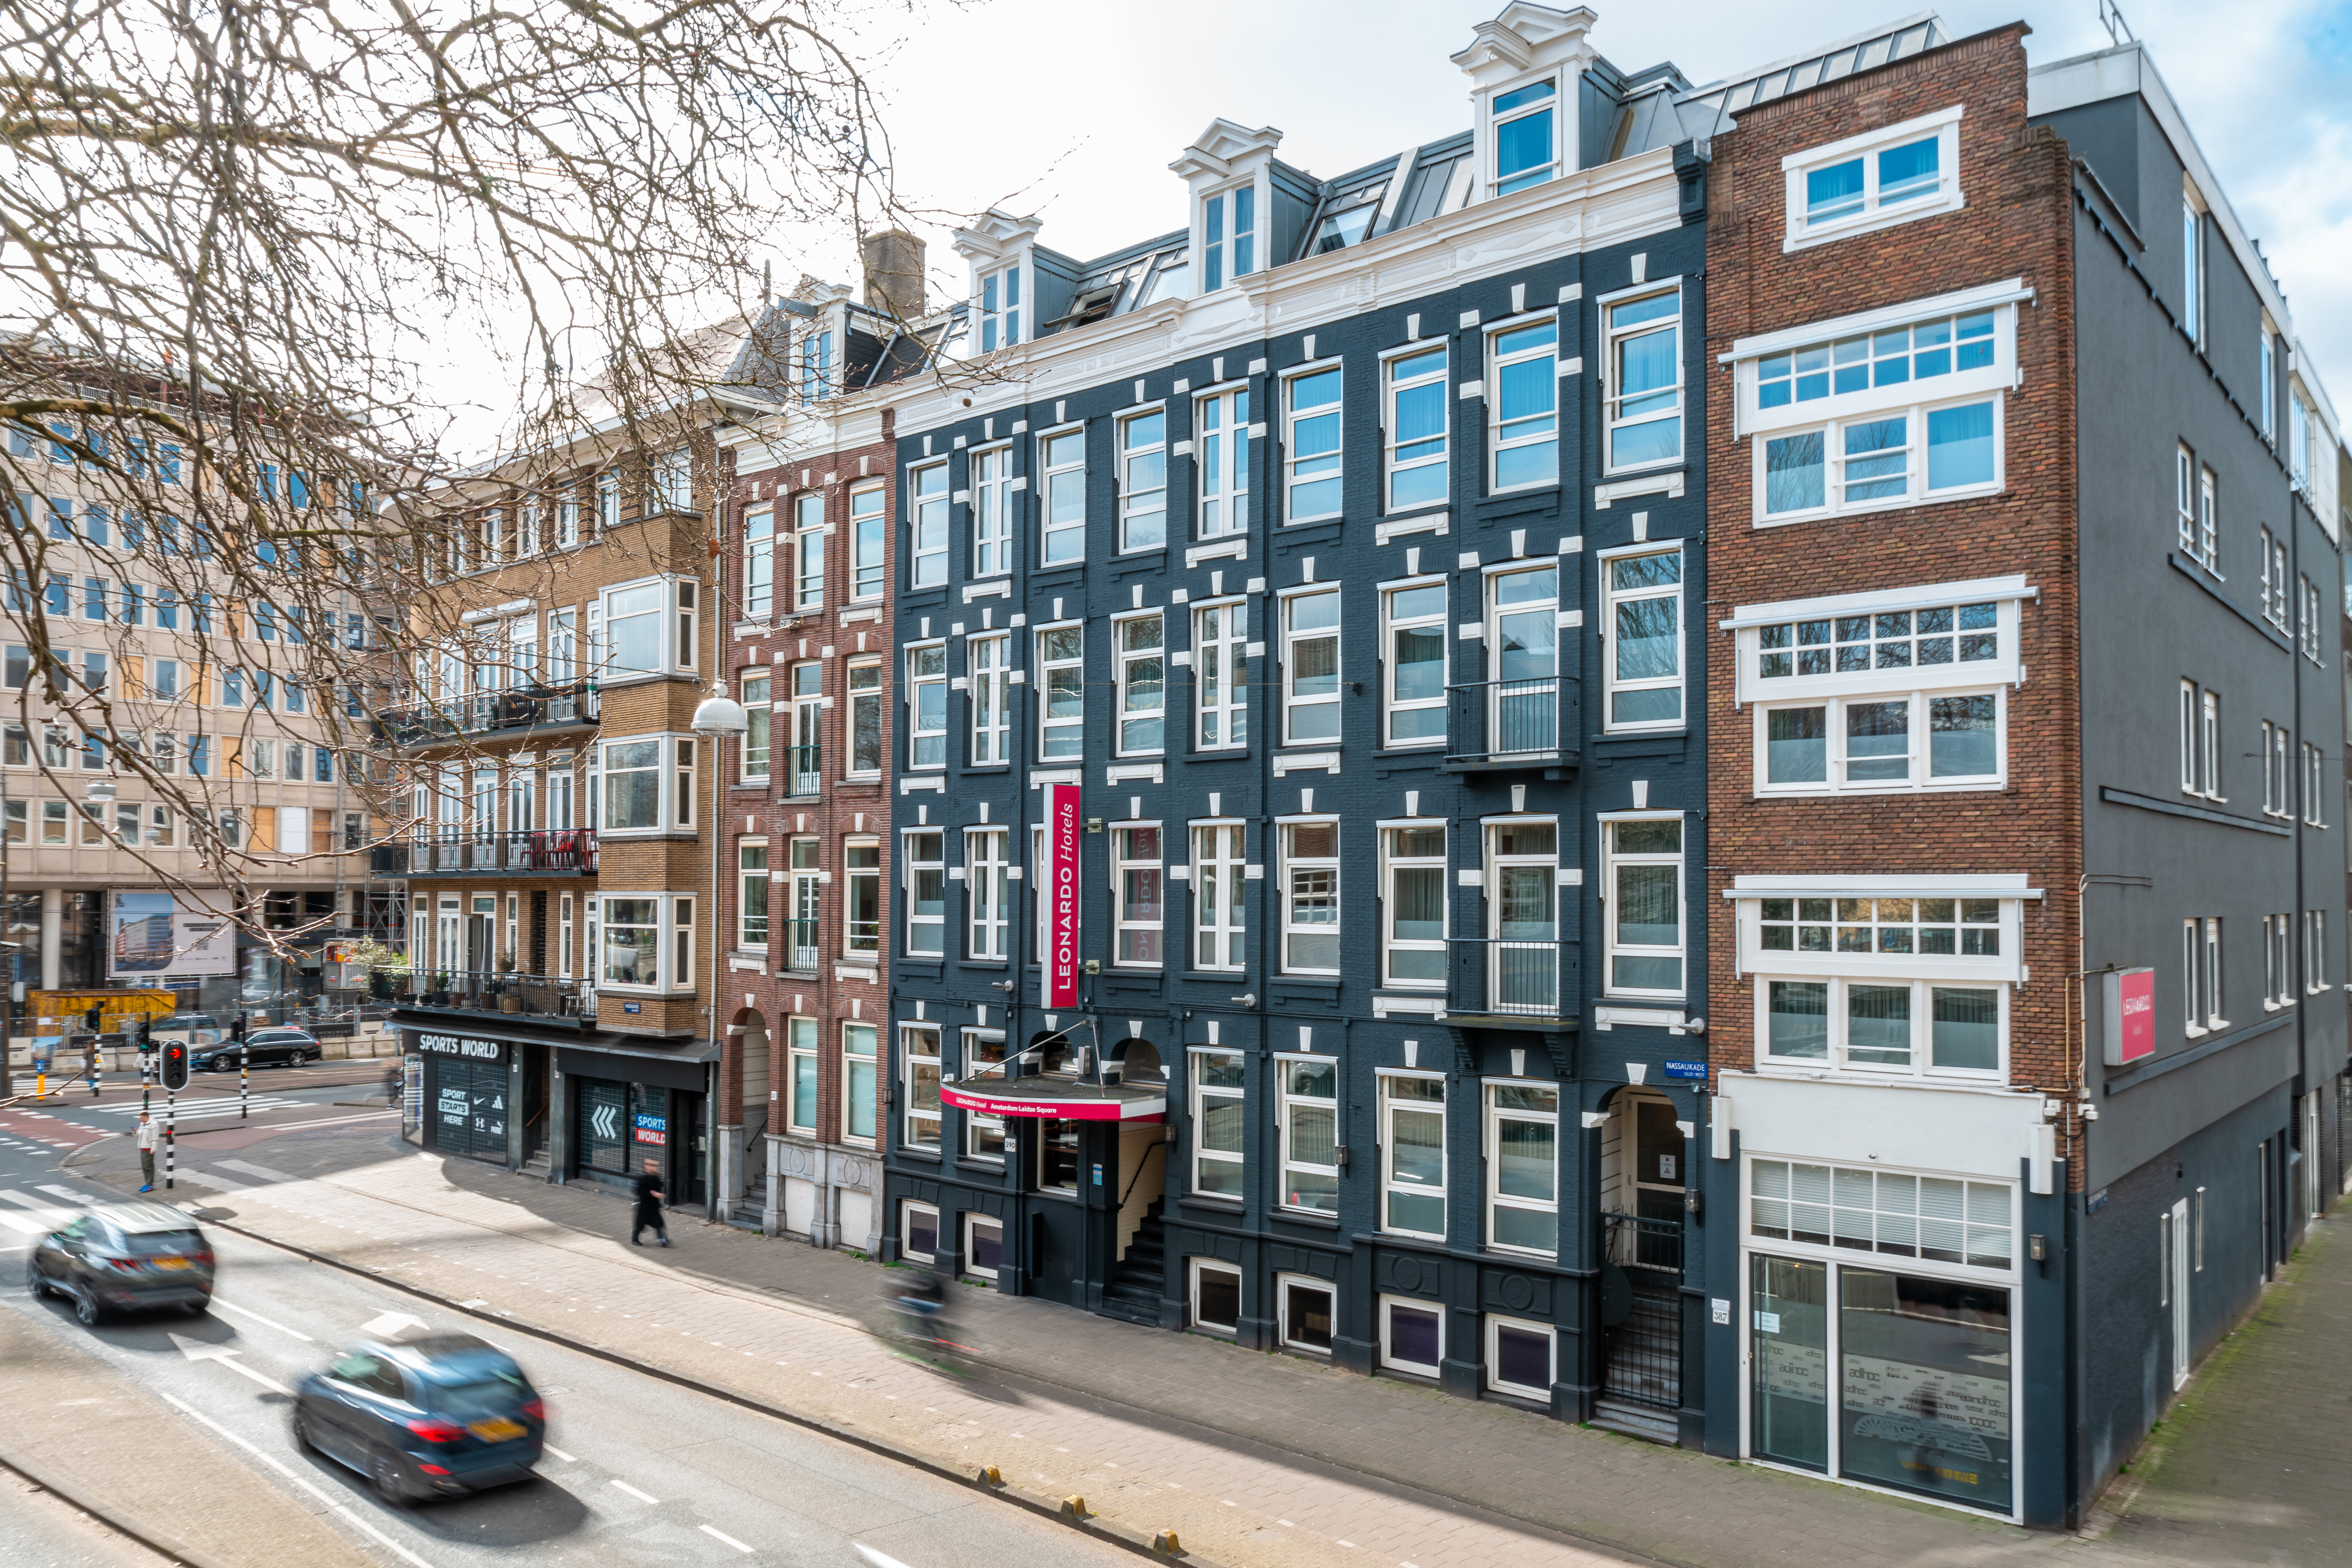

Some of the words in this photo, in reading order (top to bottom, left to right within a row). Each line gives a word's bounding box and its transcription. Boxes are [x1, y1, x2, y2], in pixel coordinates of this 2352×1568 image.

[1060, 803, 1073, 862] Hotels
[1059, 867, 1072, 989] LEONARDO
[420, 1034, 458, 1054] SPORTS
[461, 1039, 499, 1058] WORLD
[1666, 1062, 1705, 1071] NASSAUKADE
[442, 1088, 466, 1100] SPORT
[441, 1101, 466, 1113] STARTS
[957, 1097, 976, 1106] LEONARDO
[991, 1103, 1018, 1111] Amsterdam
[444, 1114, 463, 1125] HERE
[638, 1116, 665, 1130] SPORTS
[638, 1130, 665, 1144] WORLD
[1714, 1311, 1727, 1321] 387
[1805, 1350, 1823, 1358] adhoc
[1779, 1363, 1808, 1376] adhoc
[1848, 1367, 1880, 1382] adhoc
[1844, 1385, 1867, 1395] adhoc
[1845, 1399, 1864, 1408] adhoc
